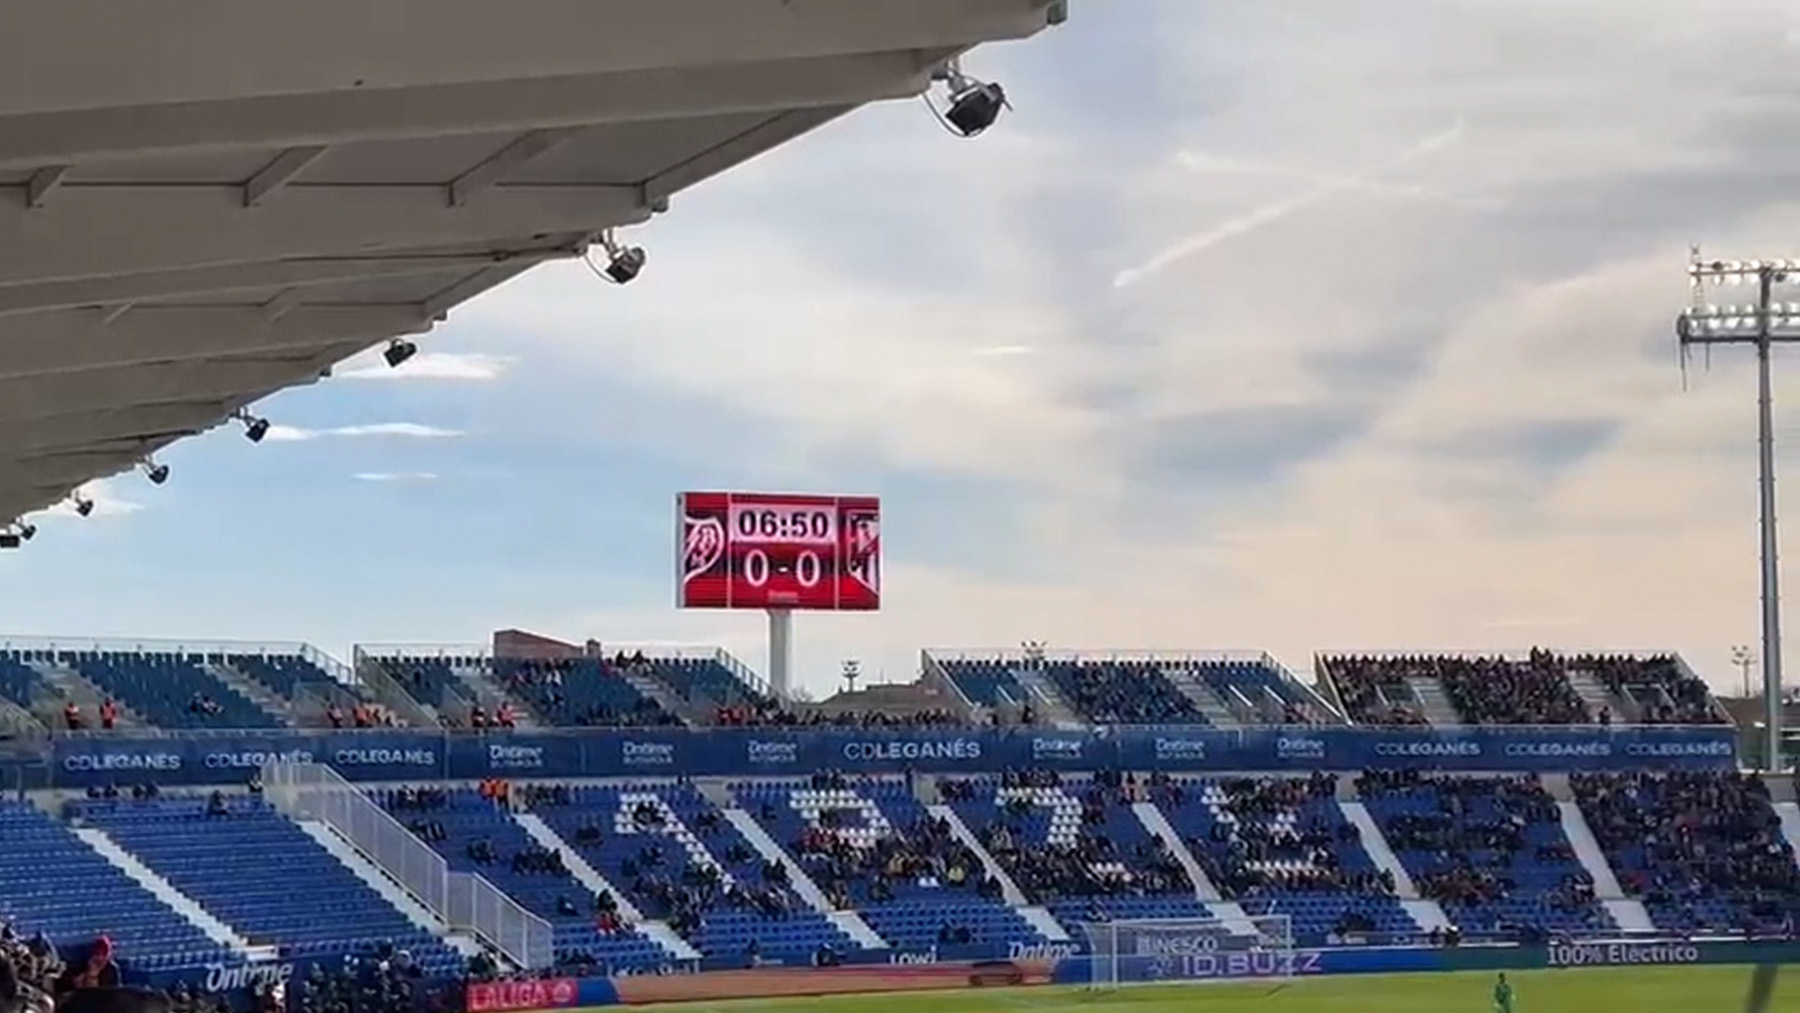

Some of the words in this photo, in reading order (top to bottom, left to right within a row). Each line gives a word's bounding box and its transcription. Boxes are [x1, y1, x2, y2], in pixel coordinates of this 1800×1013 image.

[739, 510, 828, 538] 06:50
[745, 549, 769, 587] 0
[796, 550, 820, 588] 0
[1547, 944, 1603, 965] 100%
